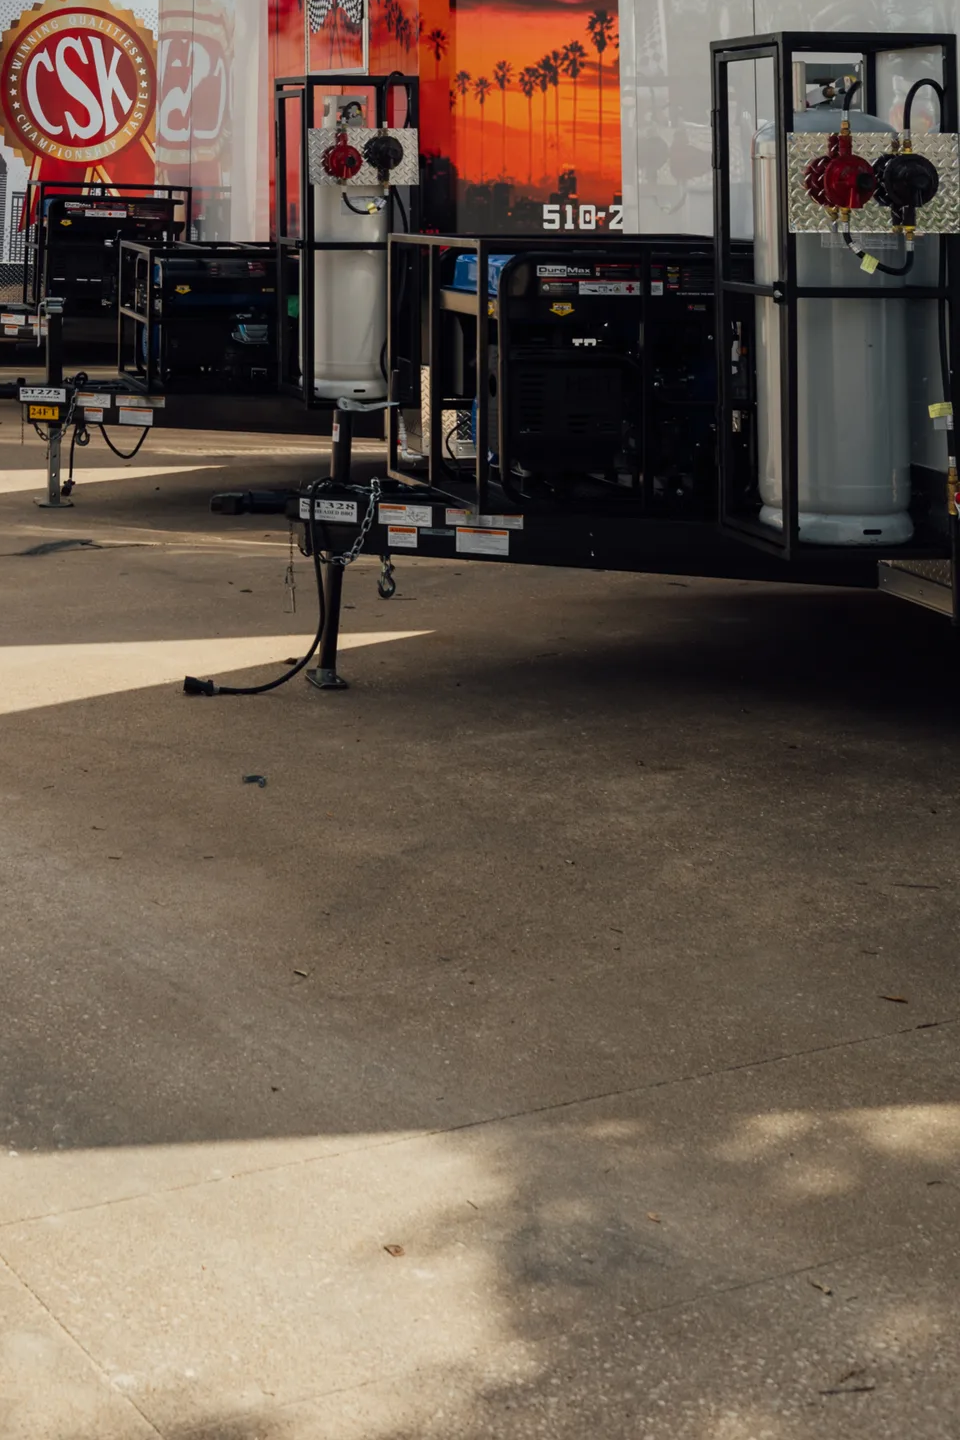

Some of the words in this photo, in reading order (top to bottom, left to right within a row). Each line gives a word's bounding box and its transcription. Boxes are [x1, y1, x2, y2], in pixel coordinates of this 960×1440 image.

[11, 19, 60, 71] WINNING
[69, 14, 139, 57] QUALITIES
[26, 35, 134, 140] CSK
[16, 113, 119, 160] CHAMPIONSHIP
[123, 91, 149, 138] TASTE
[542, 203, 624, 230] 510-2
[20, 388, 61, 397] ST275
[30, 407, 57, 417] 24FT
[301, 500, 356, 511] ST328
